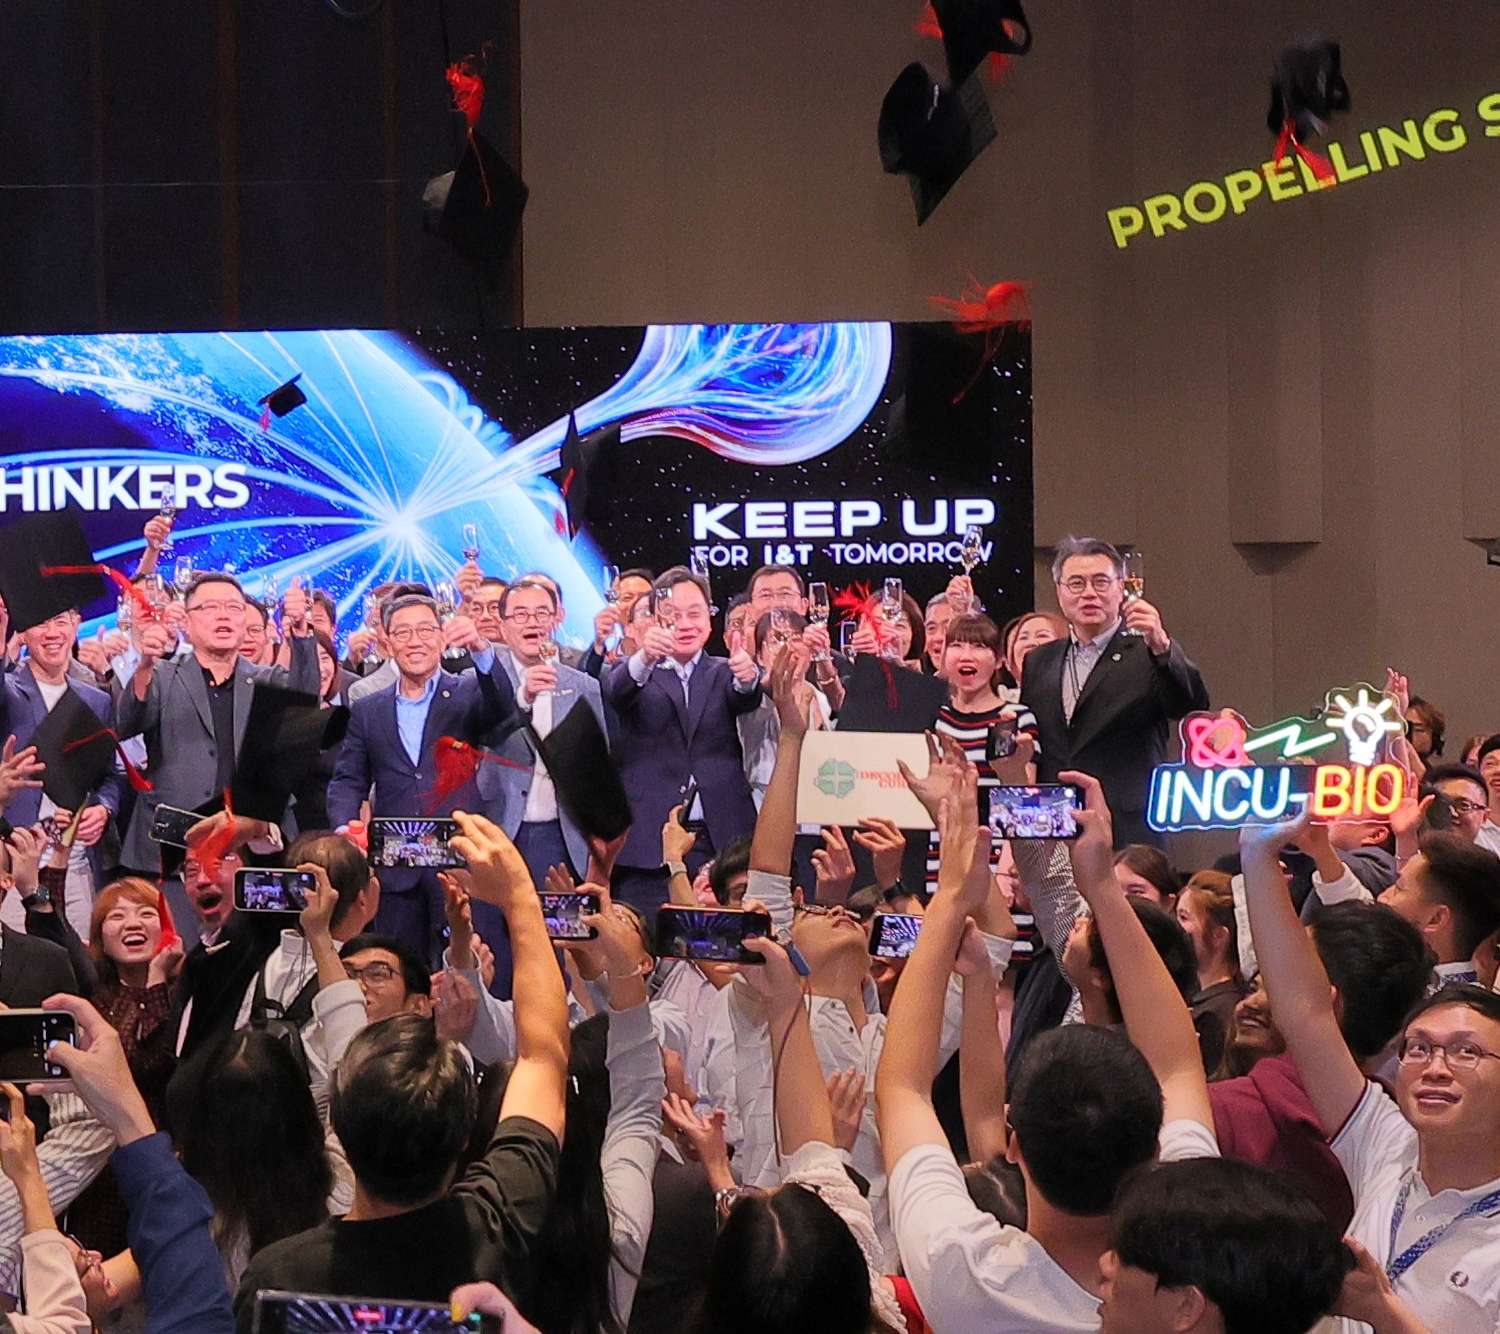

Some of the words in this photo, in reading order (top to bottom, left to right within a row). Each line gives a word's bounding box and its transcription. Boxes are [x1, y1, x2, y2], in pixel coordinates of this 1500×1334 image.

[1107, 110, 1468, 249] PROPELLING
[692, 499, 882, 541] KEEP
[902, 498, 996, 537] UP
[693, 544, 749, 567] FOR
[763, 543, 814, 566] I&T
[1155, 763, 1405, 824] INCU-BIO
